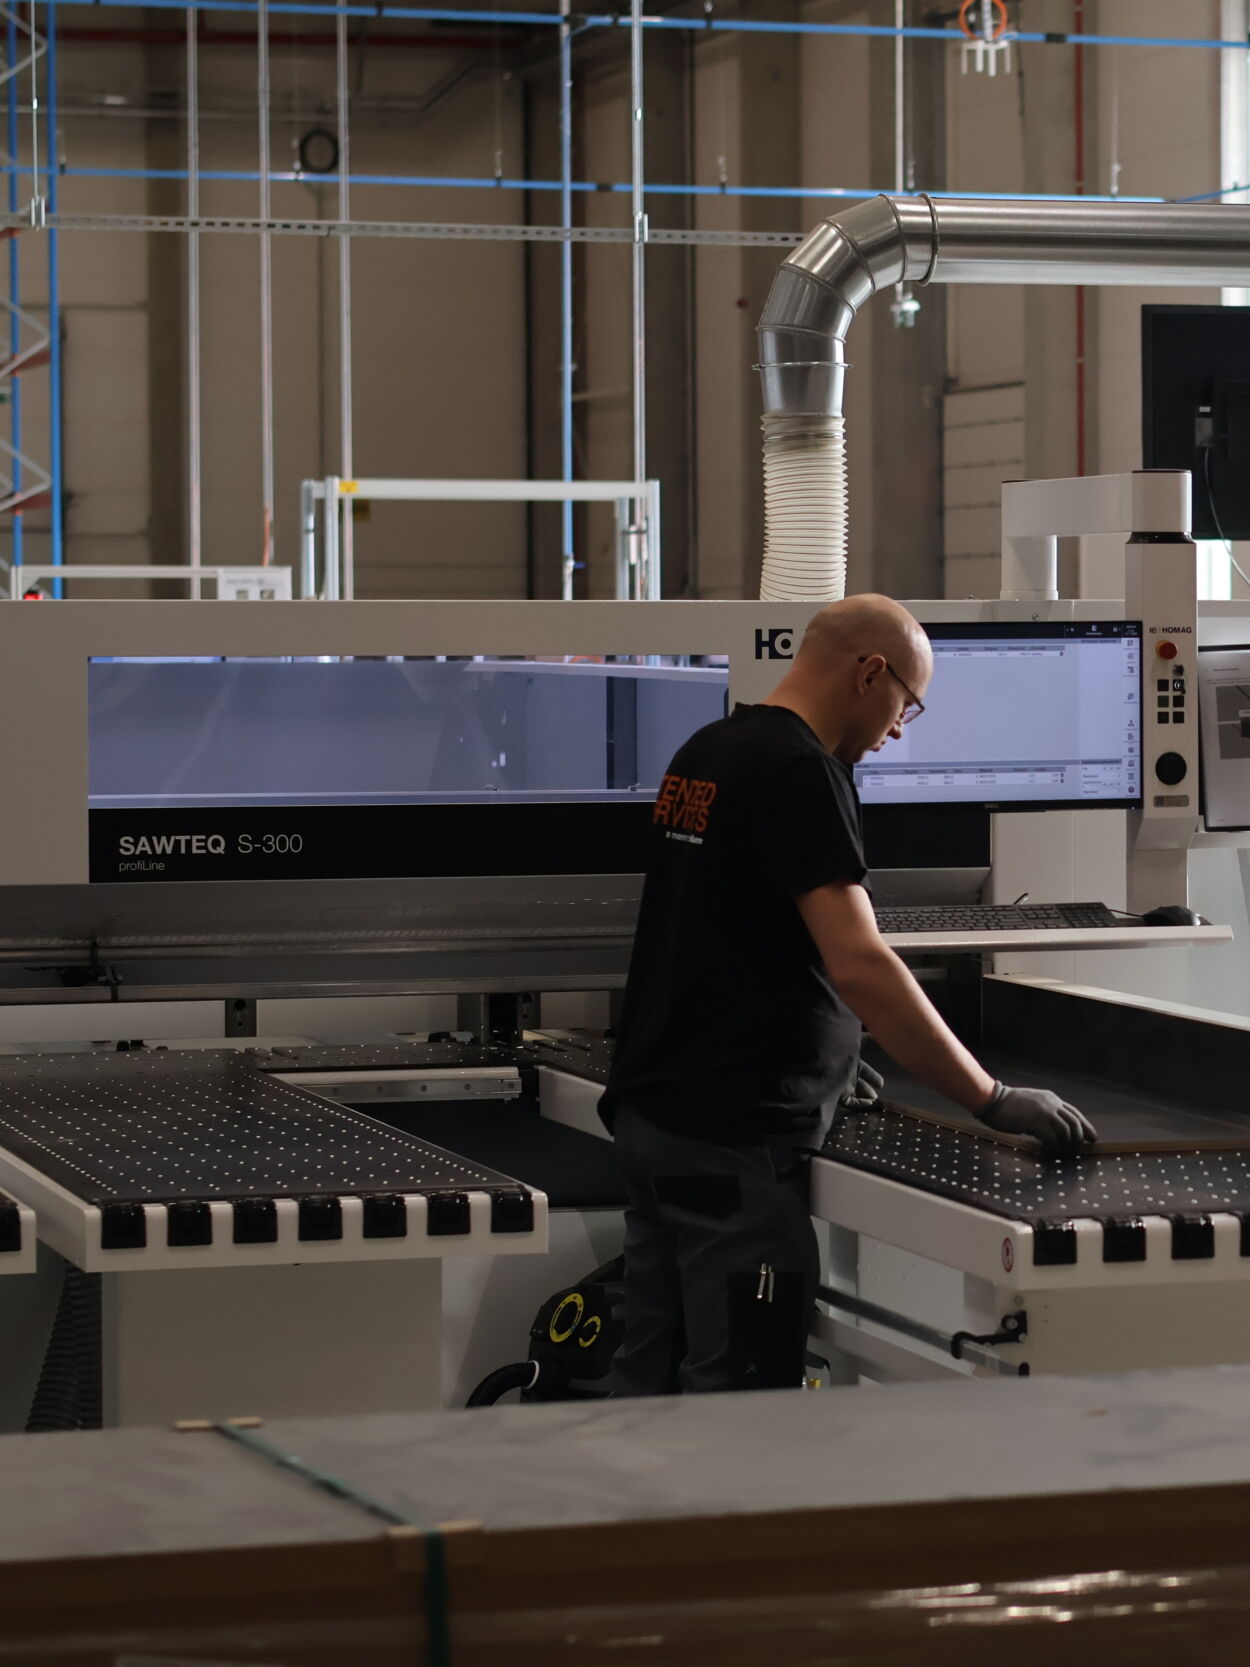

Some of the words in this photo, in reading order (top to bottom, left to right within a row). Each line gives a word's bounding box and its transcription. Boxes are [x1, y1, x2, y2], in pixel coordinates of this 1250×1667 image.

[119, 834, 226, 856] SAWTEQ
[237, 833, 303, 854] S-300
[119, 860, 166, 872] profiLine
